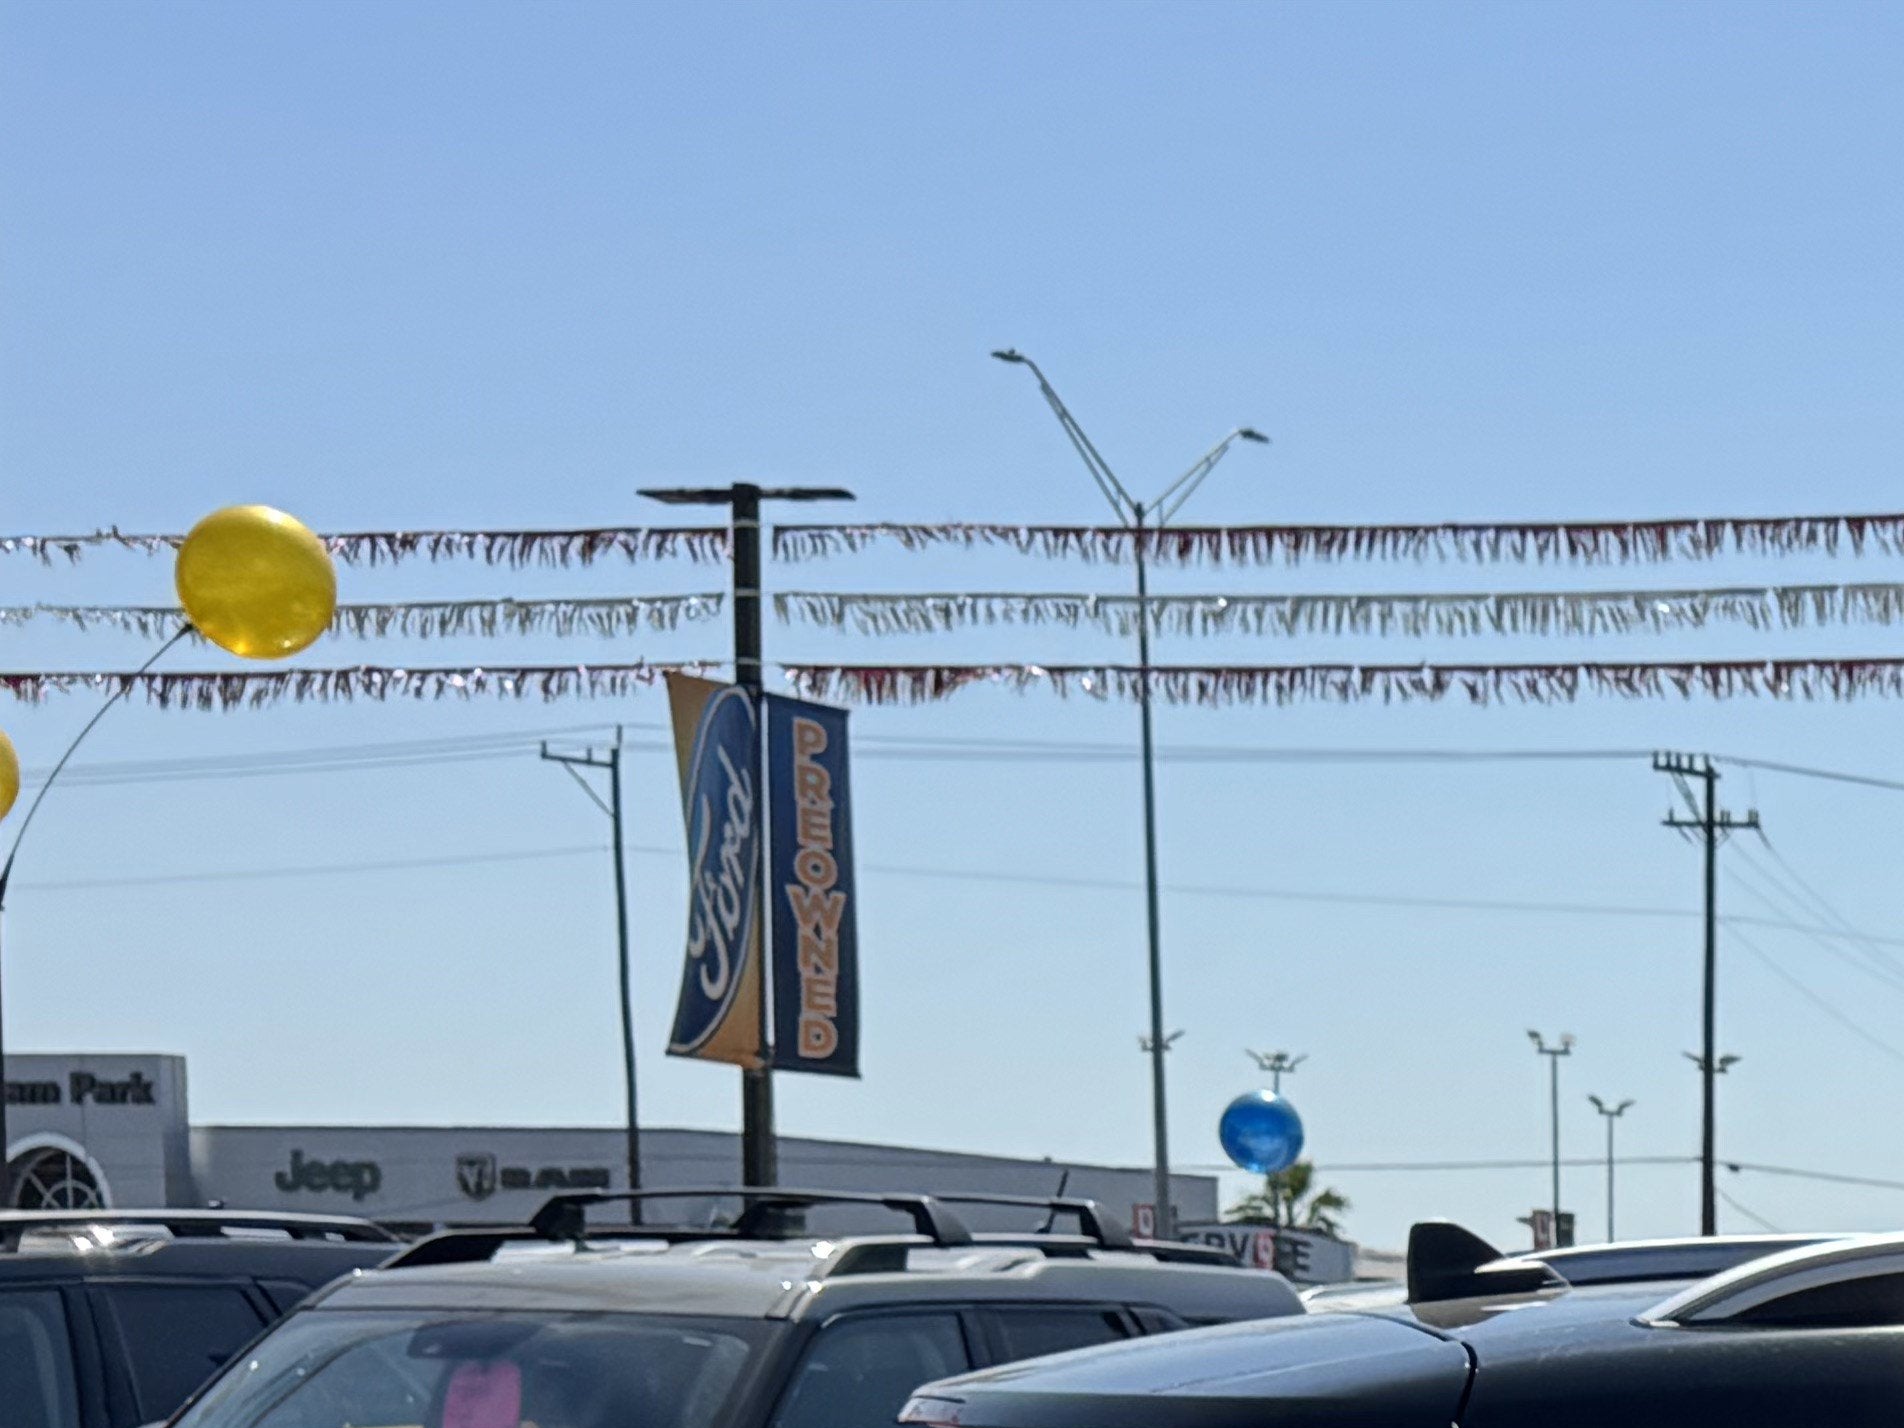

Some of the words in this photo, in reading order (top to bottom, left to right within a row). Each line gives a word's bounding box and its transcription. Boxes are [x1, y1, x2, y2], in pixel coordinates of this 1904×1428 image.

[690, 744, 754, 1001] Ford
[4, 1081, 61, 1105] am
[69, 1071, 155, 1105] Park
[275, 1149, 381, 1201] Jeep
